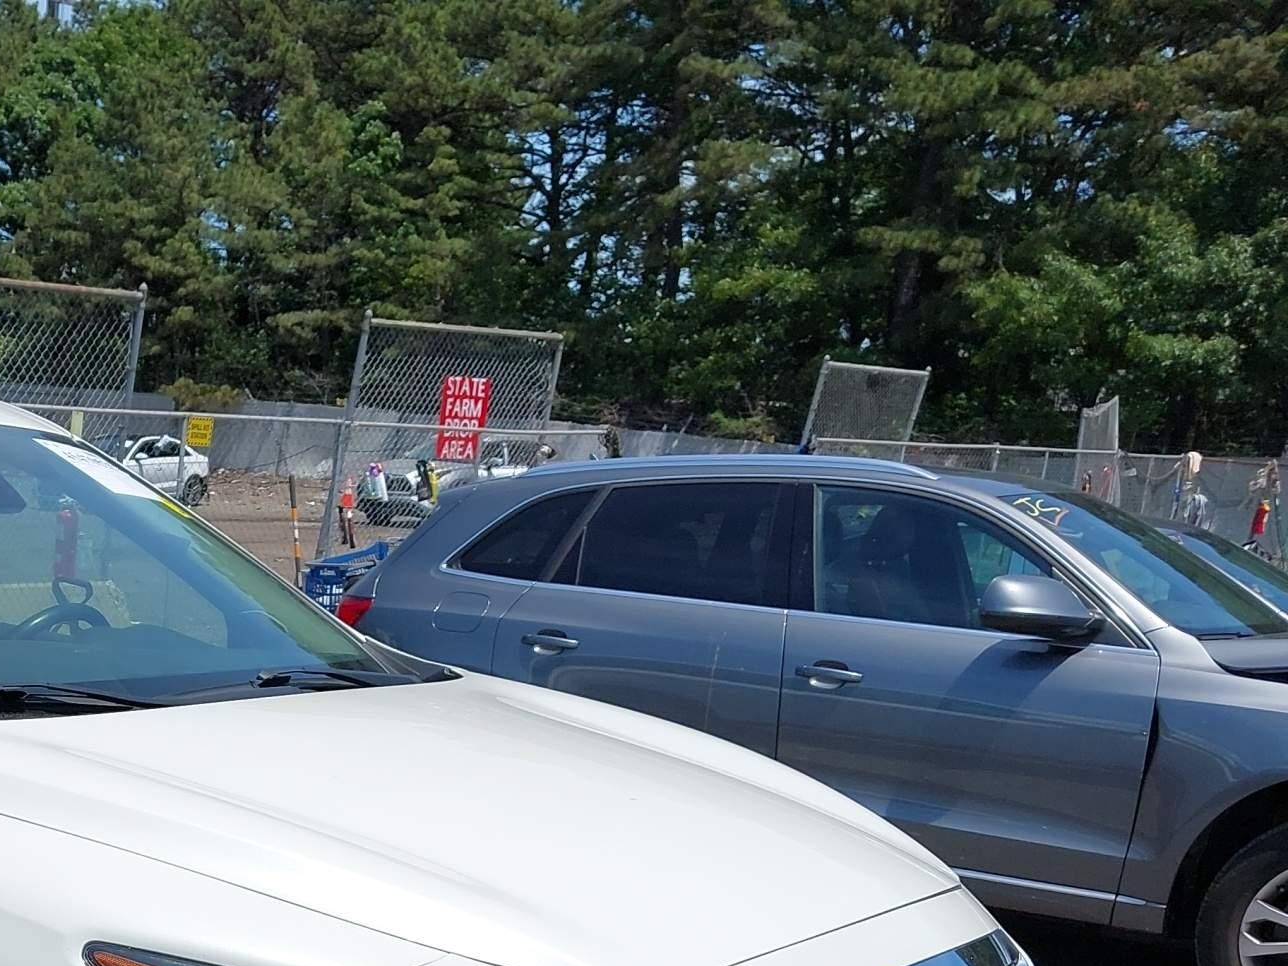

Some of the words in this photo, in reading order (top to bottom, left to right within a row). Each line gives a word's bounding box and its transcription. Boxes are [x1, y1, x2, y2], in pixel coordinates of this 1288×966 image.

[446, 376, 488, 397] STATE
[445, 397, 483, 418] FARM
[443, 418, 479, 438] DROP
[440, 440, 473, 460] AREA
